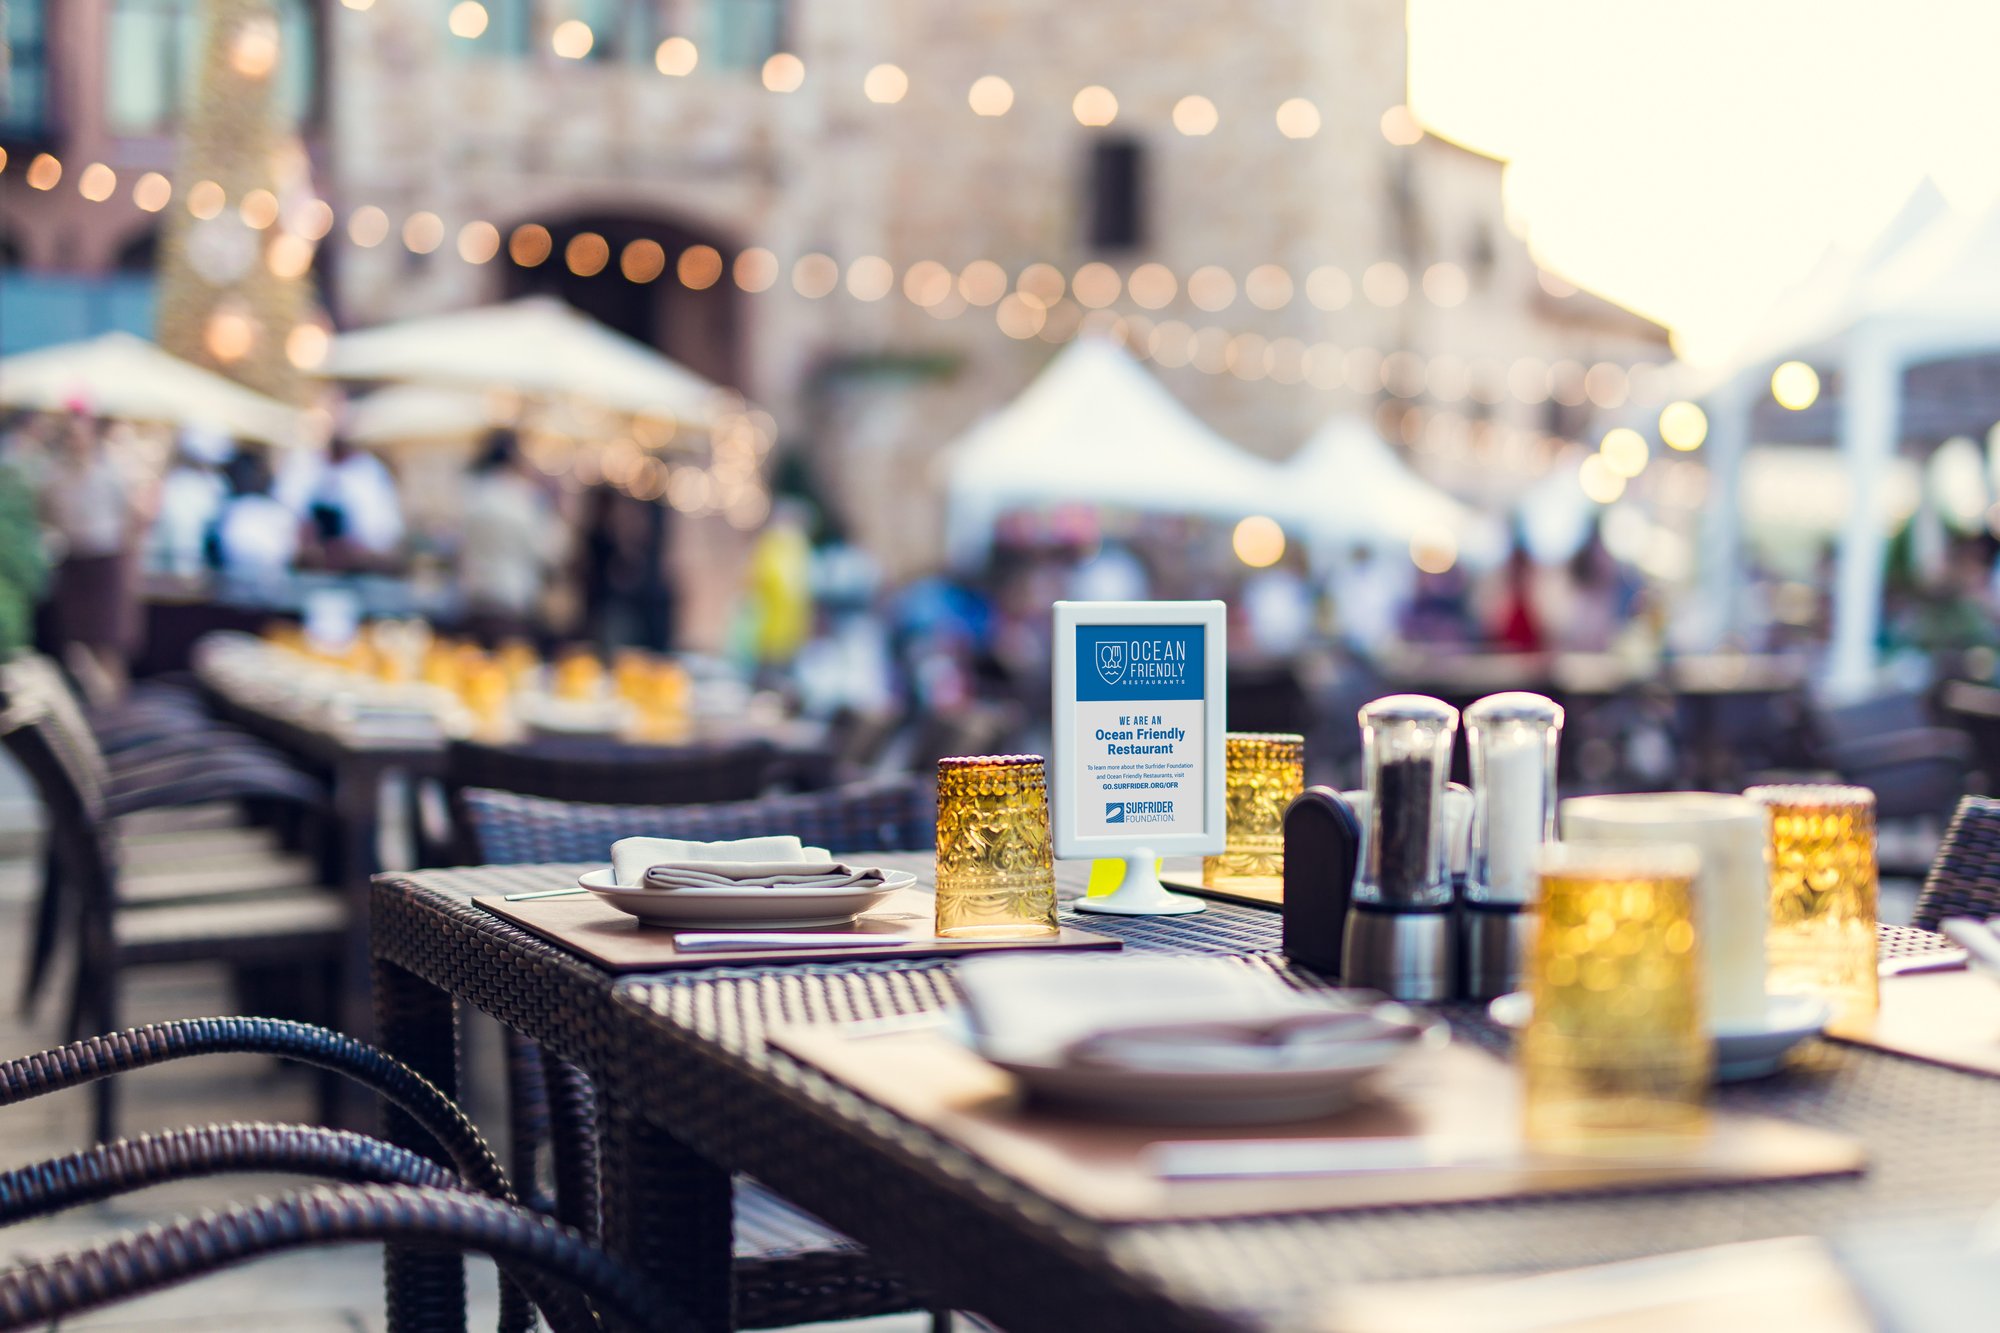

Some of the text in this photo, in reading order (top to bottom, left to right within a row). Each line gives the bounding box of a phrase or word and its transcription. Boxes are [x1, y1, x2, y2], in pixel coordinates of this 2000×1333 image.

[1131, 640, 1185, 660] OCEAN
[1130, 663, 1185, 677] FRIENDLY
[1119, 716, 1162, 725] WE ARE AN
[1096, 728, 1185, 742] Ocean Friendly
[1108, 744, 1173, 755] Restaurant
[1103, 782, 1178, 790] GO.SURFRIDER.ORG/OFR
[1126, 801, 1173, 813] SURFRIDER
